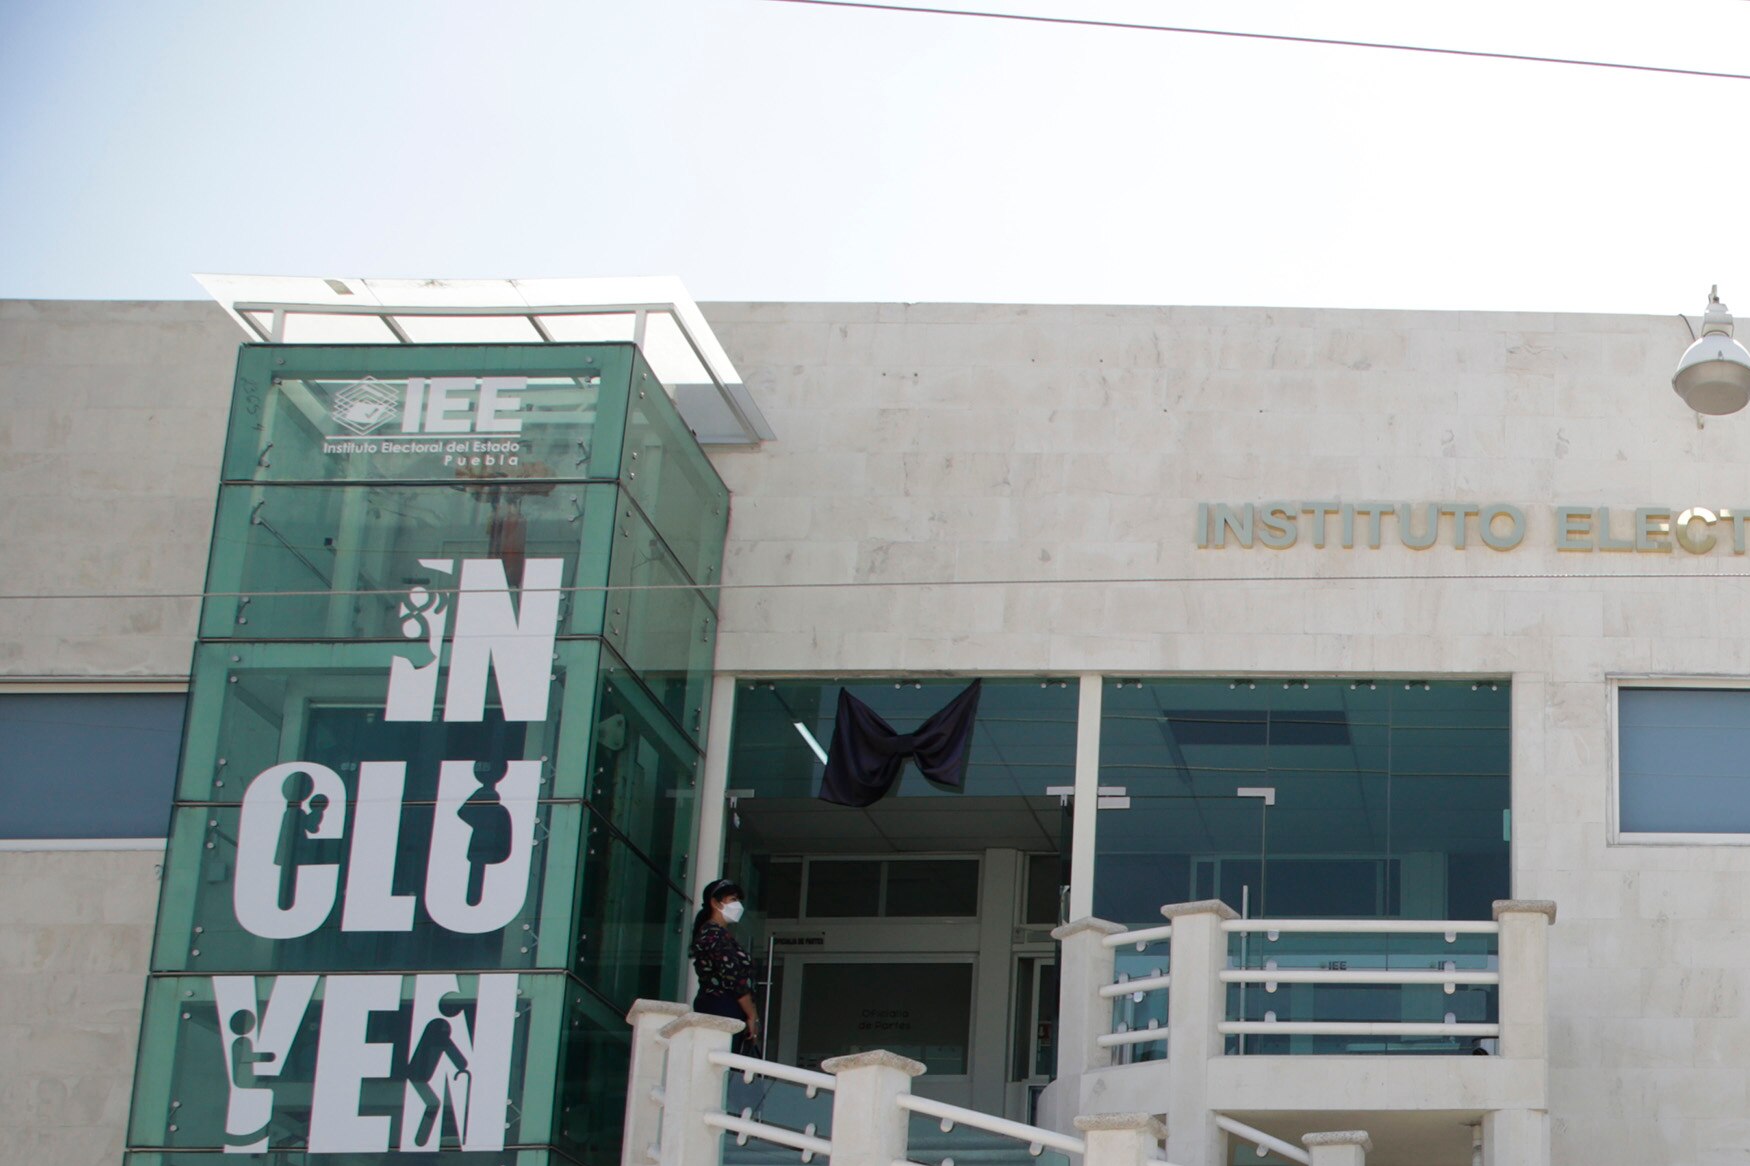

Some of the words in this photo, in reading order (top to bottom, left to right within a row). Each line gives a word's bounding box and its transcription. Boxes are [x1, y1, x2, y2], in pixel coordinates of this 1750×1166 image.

[402, 376, 528, 432] IEE
[323, 442, 377, 454] Instituto
[381, 441, 442, 453] Electoral
[446, 440, 469, 453] del
[473, 440, 520, 453] Estado
[444, 455, 519, 466] Puebla
[1197, 501, 1526, 552] INSTITUTO
[384, 558, 564, 721] IN
[233, 760, 542, 939] CLU
[212, 973, 519, 1154] YEN
